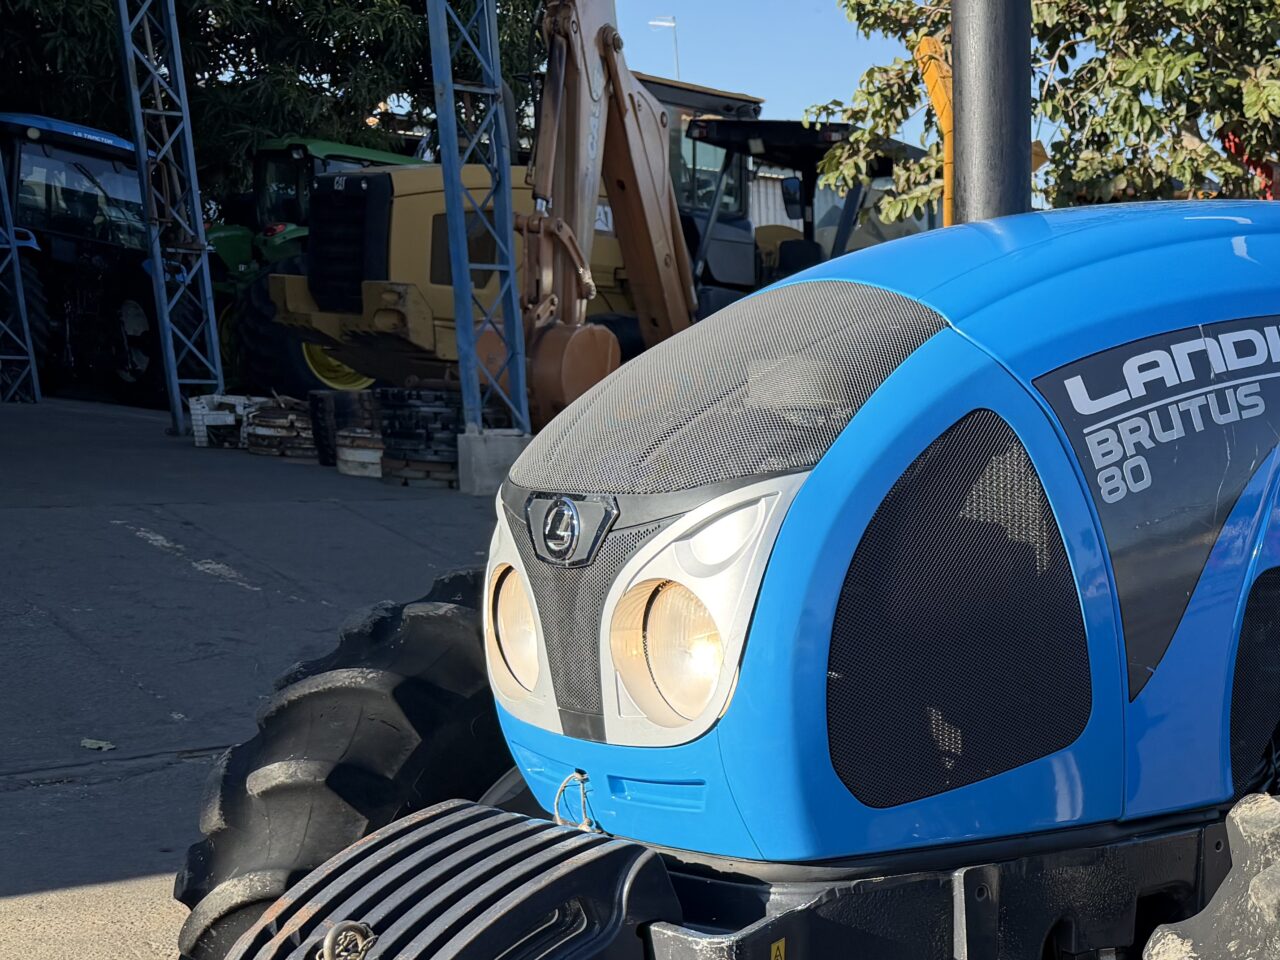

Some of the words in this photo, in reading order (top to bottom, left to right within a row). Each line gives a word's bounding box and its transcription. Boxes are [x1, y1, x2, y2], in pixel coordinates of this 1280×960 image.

[334, 176, 347, 190] CAT
[1085, 382, 1266, 470] BRUTUS
[1097, 455, 1152, 504] 80
